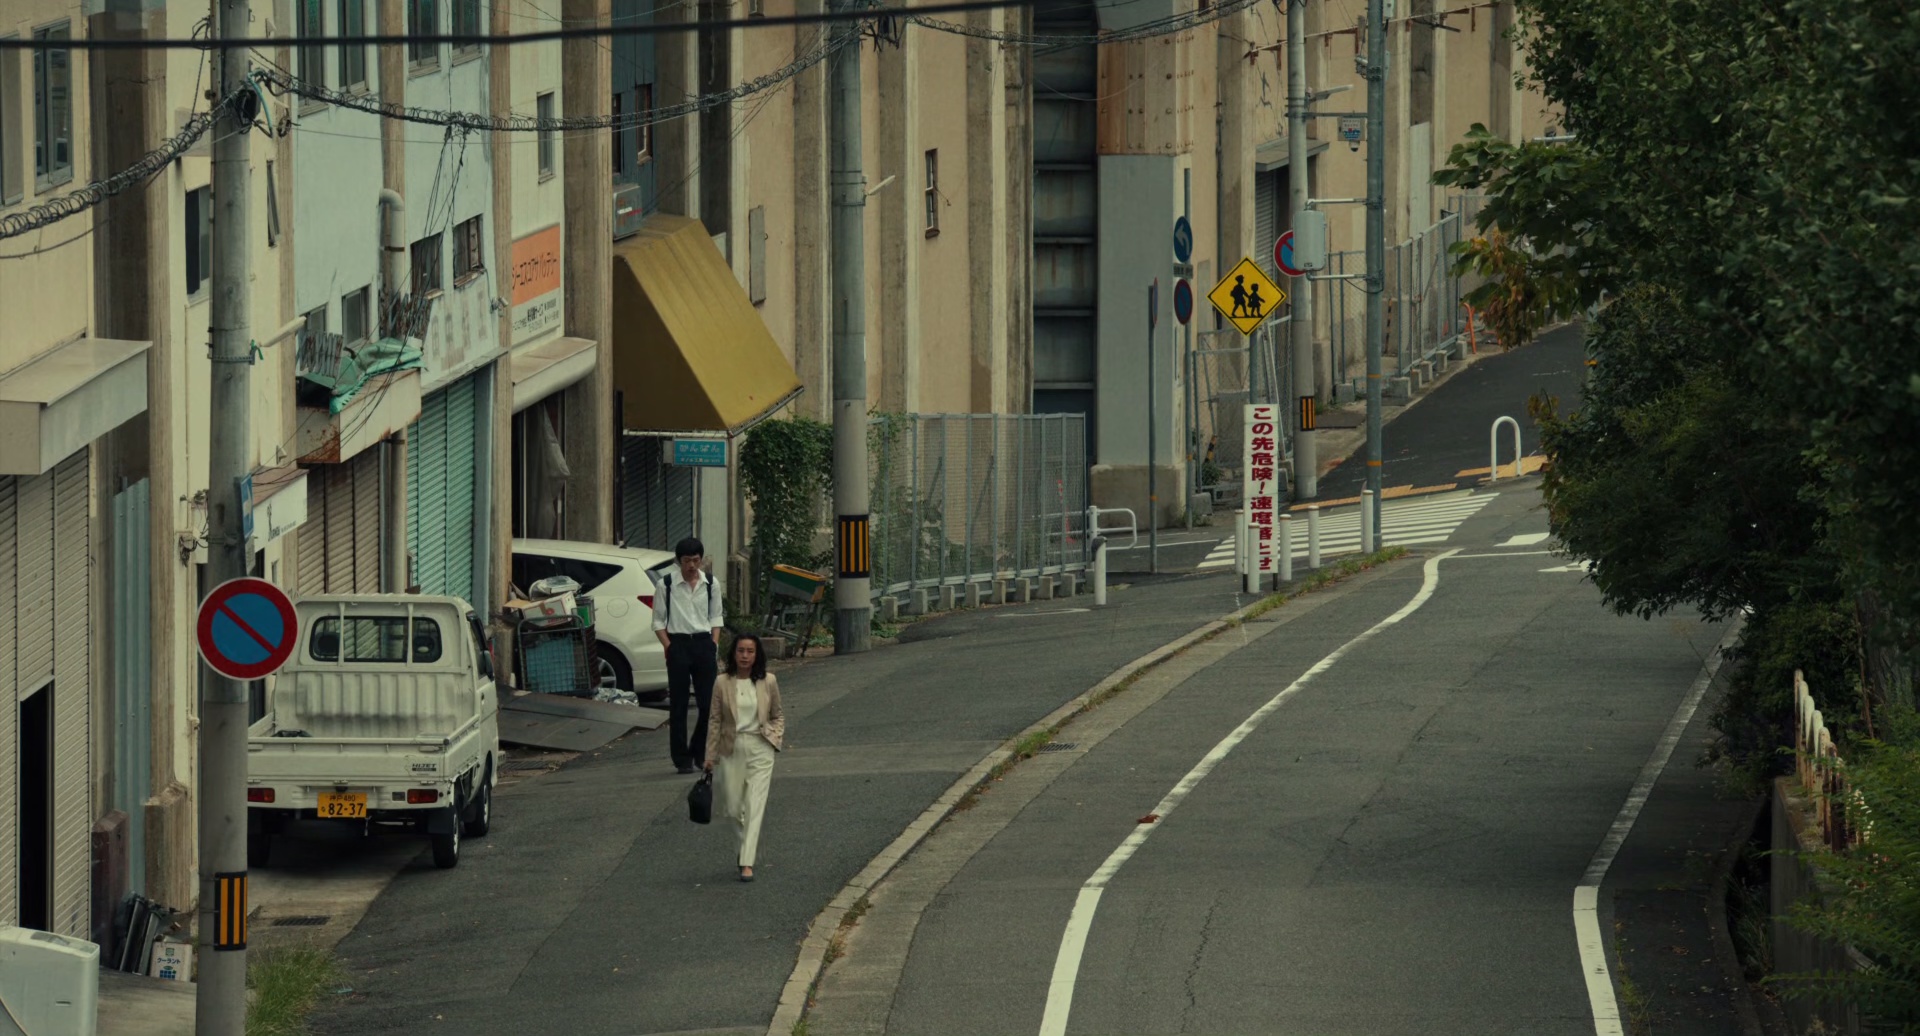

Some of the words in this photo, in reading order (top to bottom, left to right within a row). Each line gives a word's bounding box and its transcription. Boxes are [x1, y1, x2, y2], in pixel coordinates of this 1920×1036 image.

[328, 803, 364, 816] 82-37
[157, 957, 181, 965] クーラント
